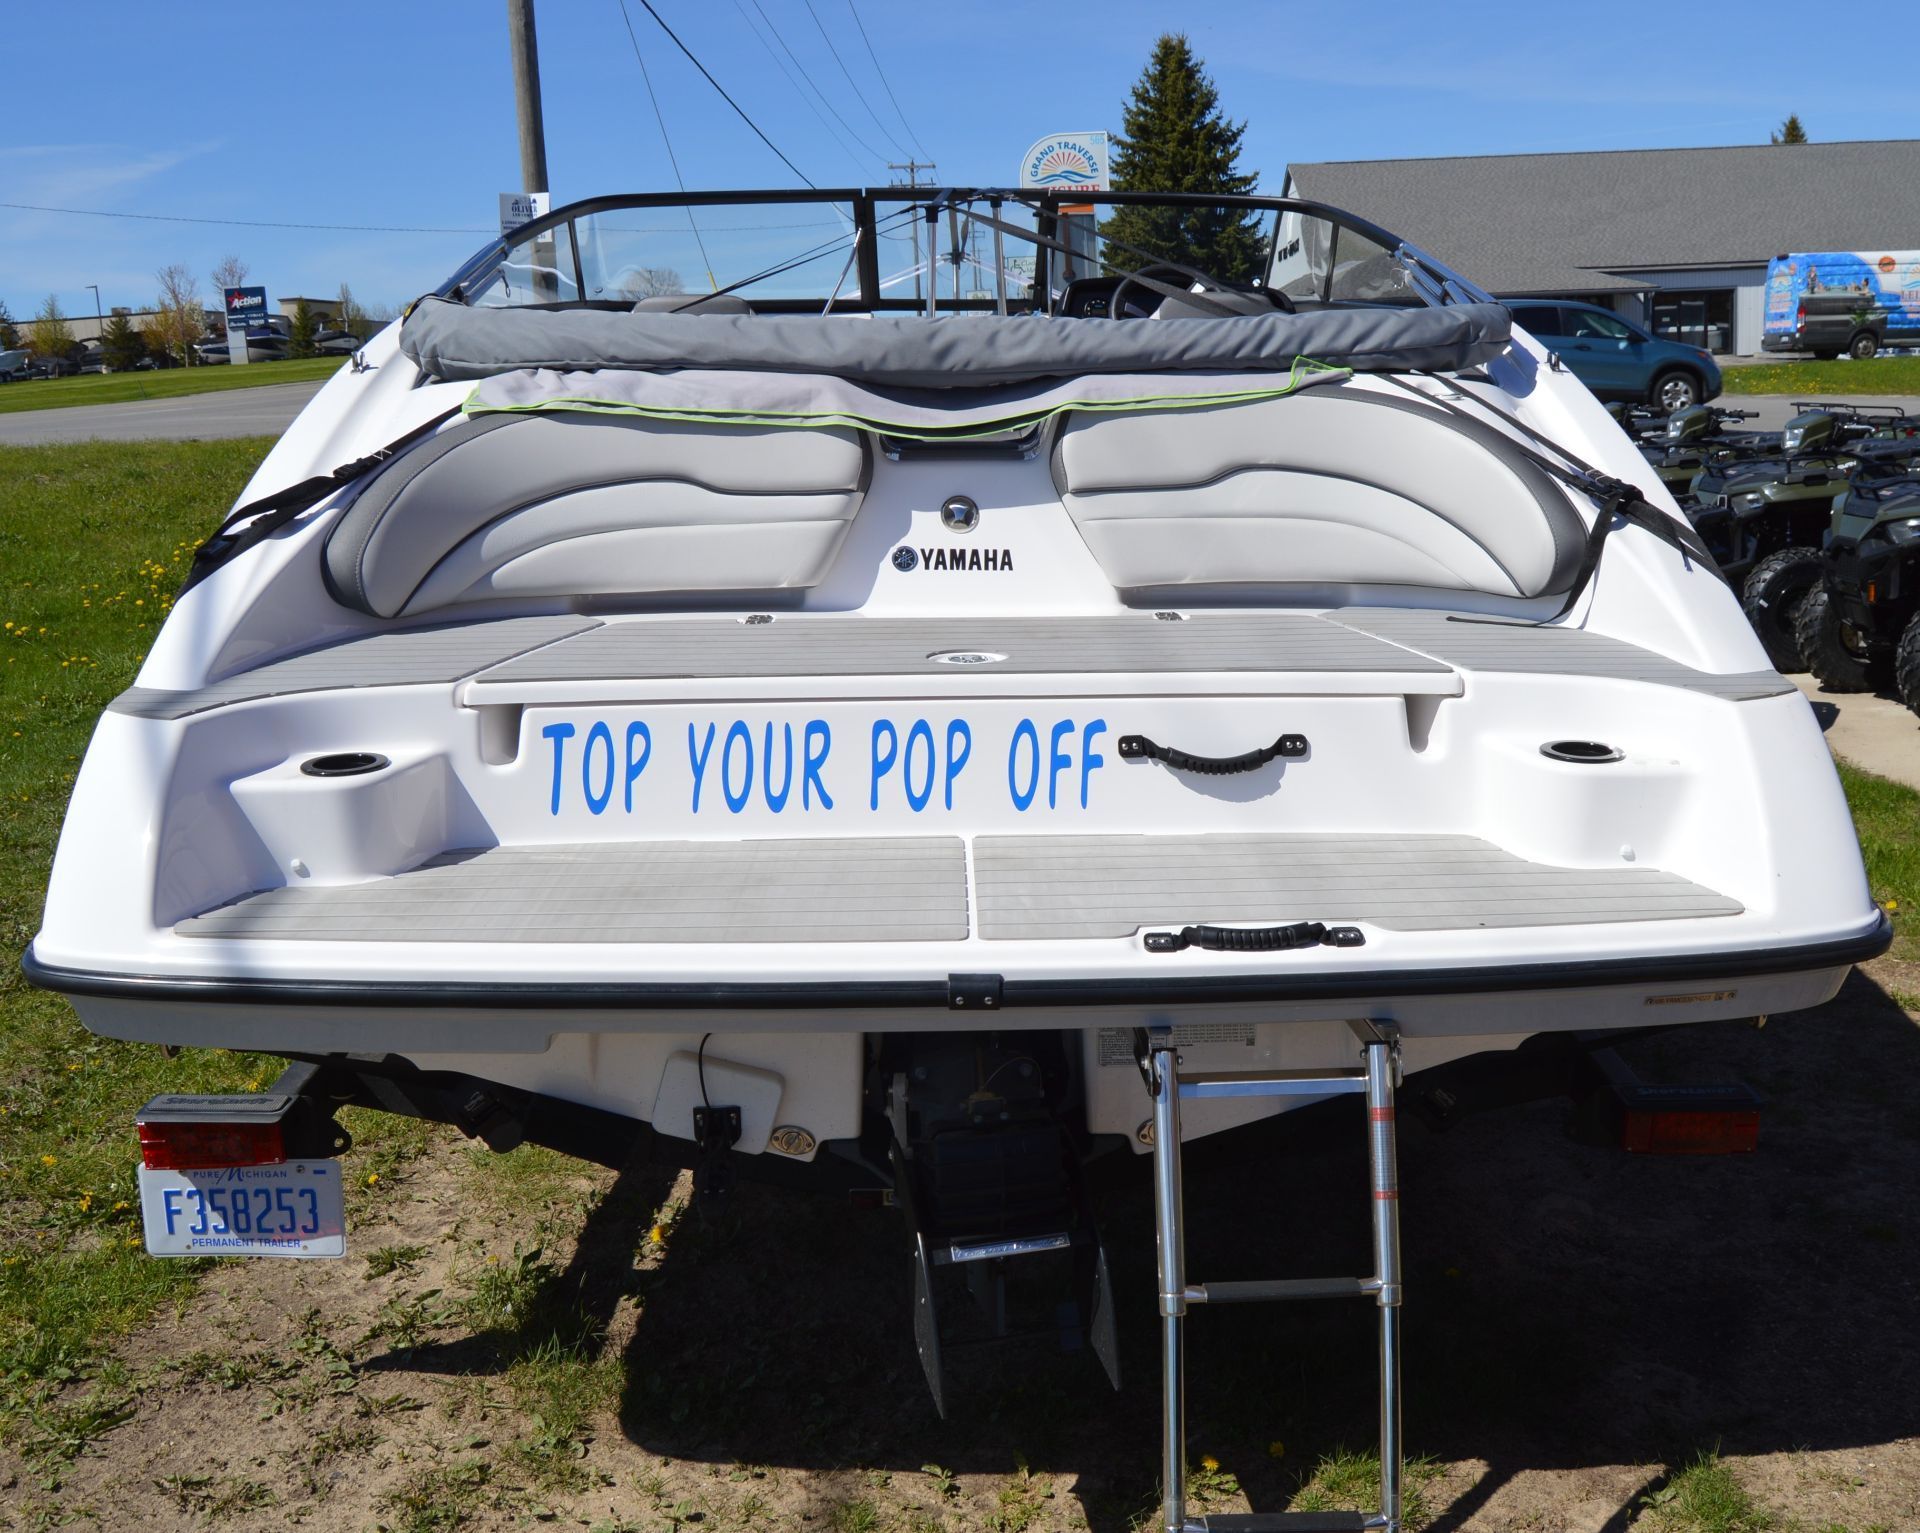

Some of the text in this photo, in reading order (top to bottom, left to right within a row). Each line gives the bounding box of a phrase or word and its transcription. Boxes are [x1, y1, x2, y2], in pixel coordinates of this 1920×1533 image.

[1030, 141, 1099, 177] GRAND TRAVERSE
[231, 296, 262, 309] Action
[920, 548, 1014, 571] YAMAHA
[543, 718, 1107, 816] TOP YOUR POP OFF
[193, 1170, 220, 1179] PURE
[162, 1187, 320, 1236] F358253
[191, 1237, 301, 1248] PERMANENT TRAILER
